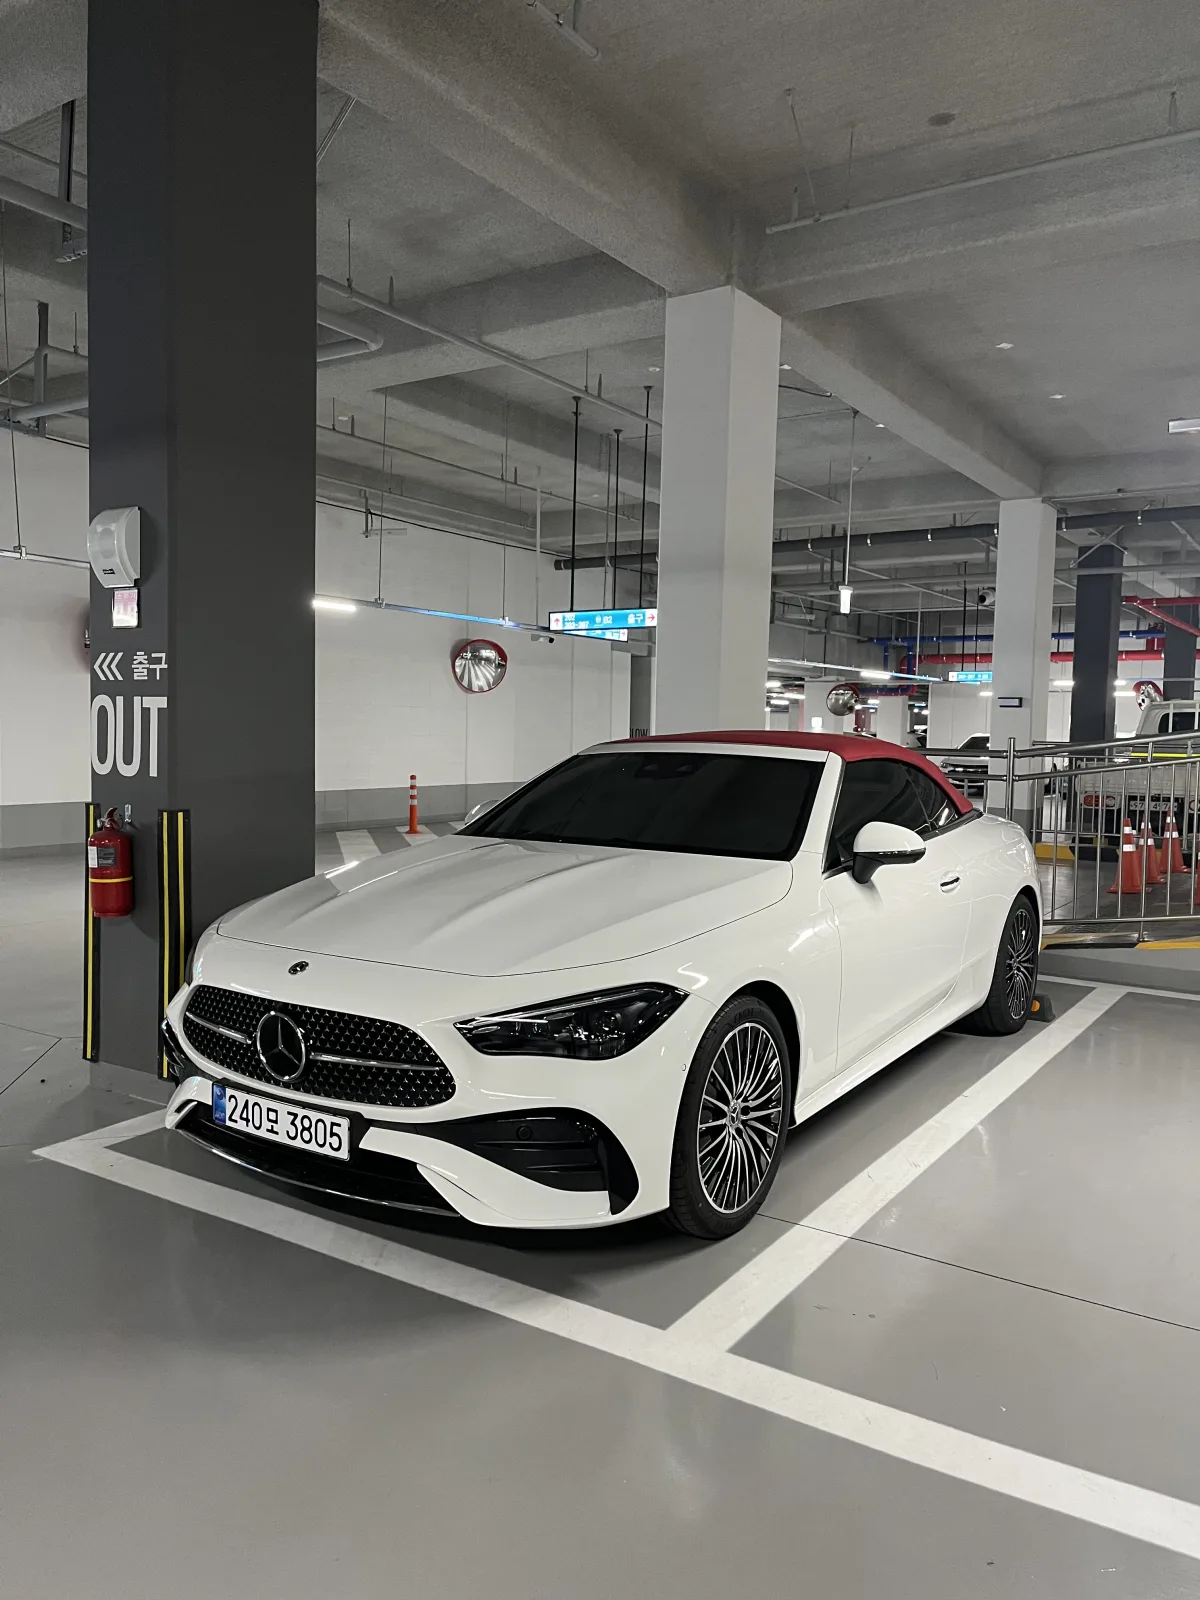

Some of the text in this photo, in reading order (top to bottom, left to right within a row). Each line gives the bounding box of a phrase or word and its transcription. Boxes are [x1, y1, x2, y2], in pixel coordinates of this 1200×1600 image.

[627, 613, 644, 624] 출구
[132, 652, 168, 680] 출구
[91, 694, 168, 777] OUT
[228, 1094, 342, 1152] 240모 3805
